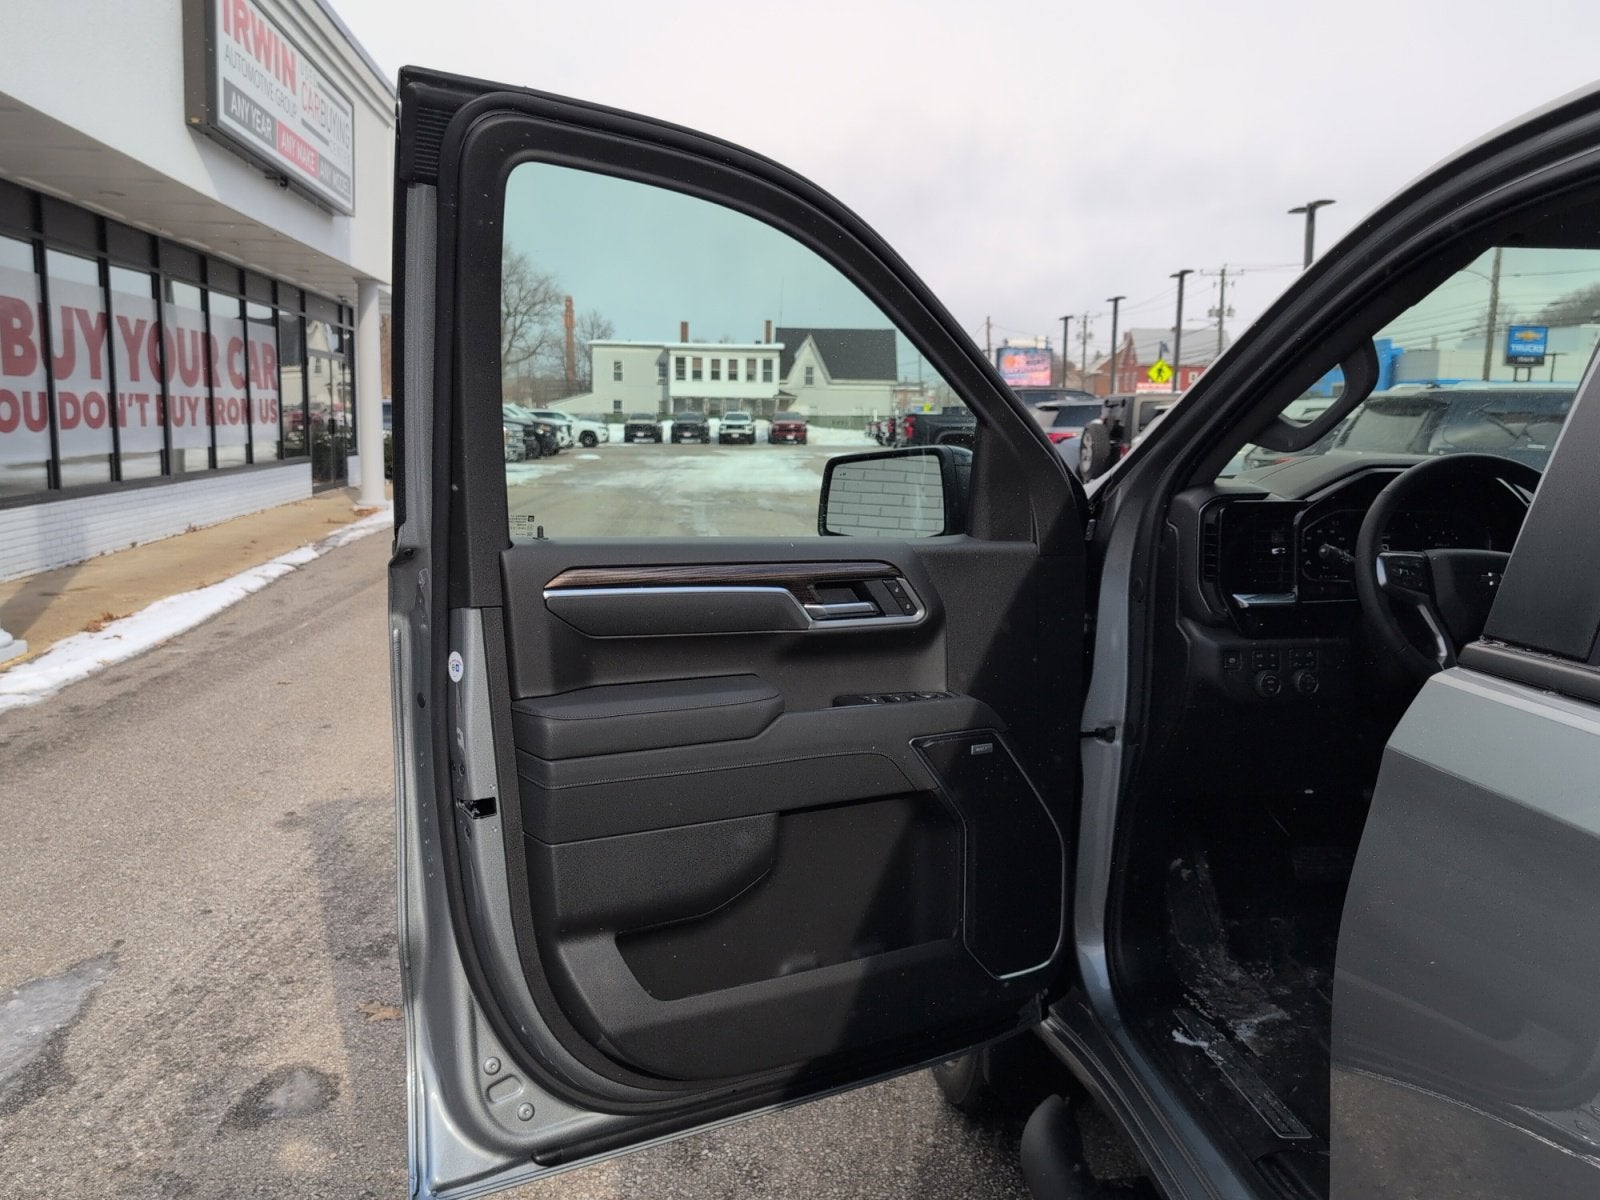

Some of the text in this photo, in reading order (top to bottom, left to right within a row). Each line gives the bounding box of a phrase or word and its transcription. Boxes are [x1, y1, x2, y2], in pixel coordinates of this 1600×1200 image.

[223, 0, 297, 96] IRWIN
[224, 43, 298, 119] AUTOMOTIVE GROUP
[231, 91, 273, 142] ANY YEAR
[281, 129, 297, 159] ANY
[0, 295, 279, 391] BUY YOUR CAR
[0, 389, 48, 433] OU
[58, 391, 150, 430] DON'T
[156, 394, 200, 428] BUY
[259, 398, 278, 425] US
